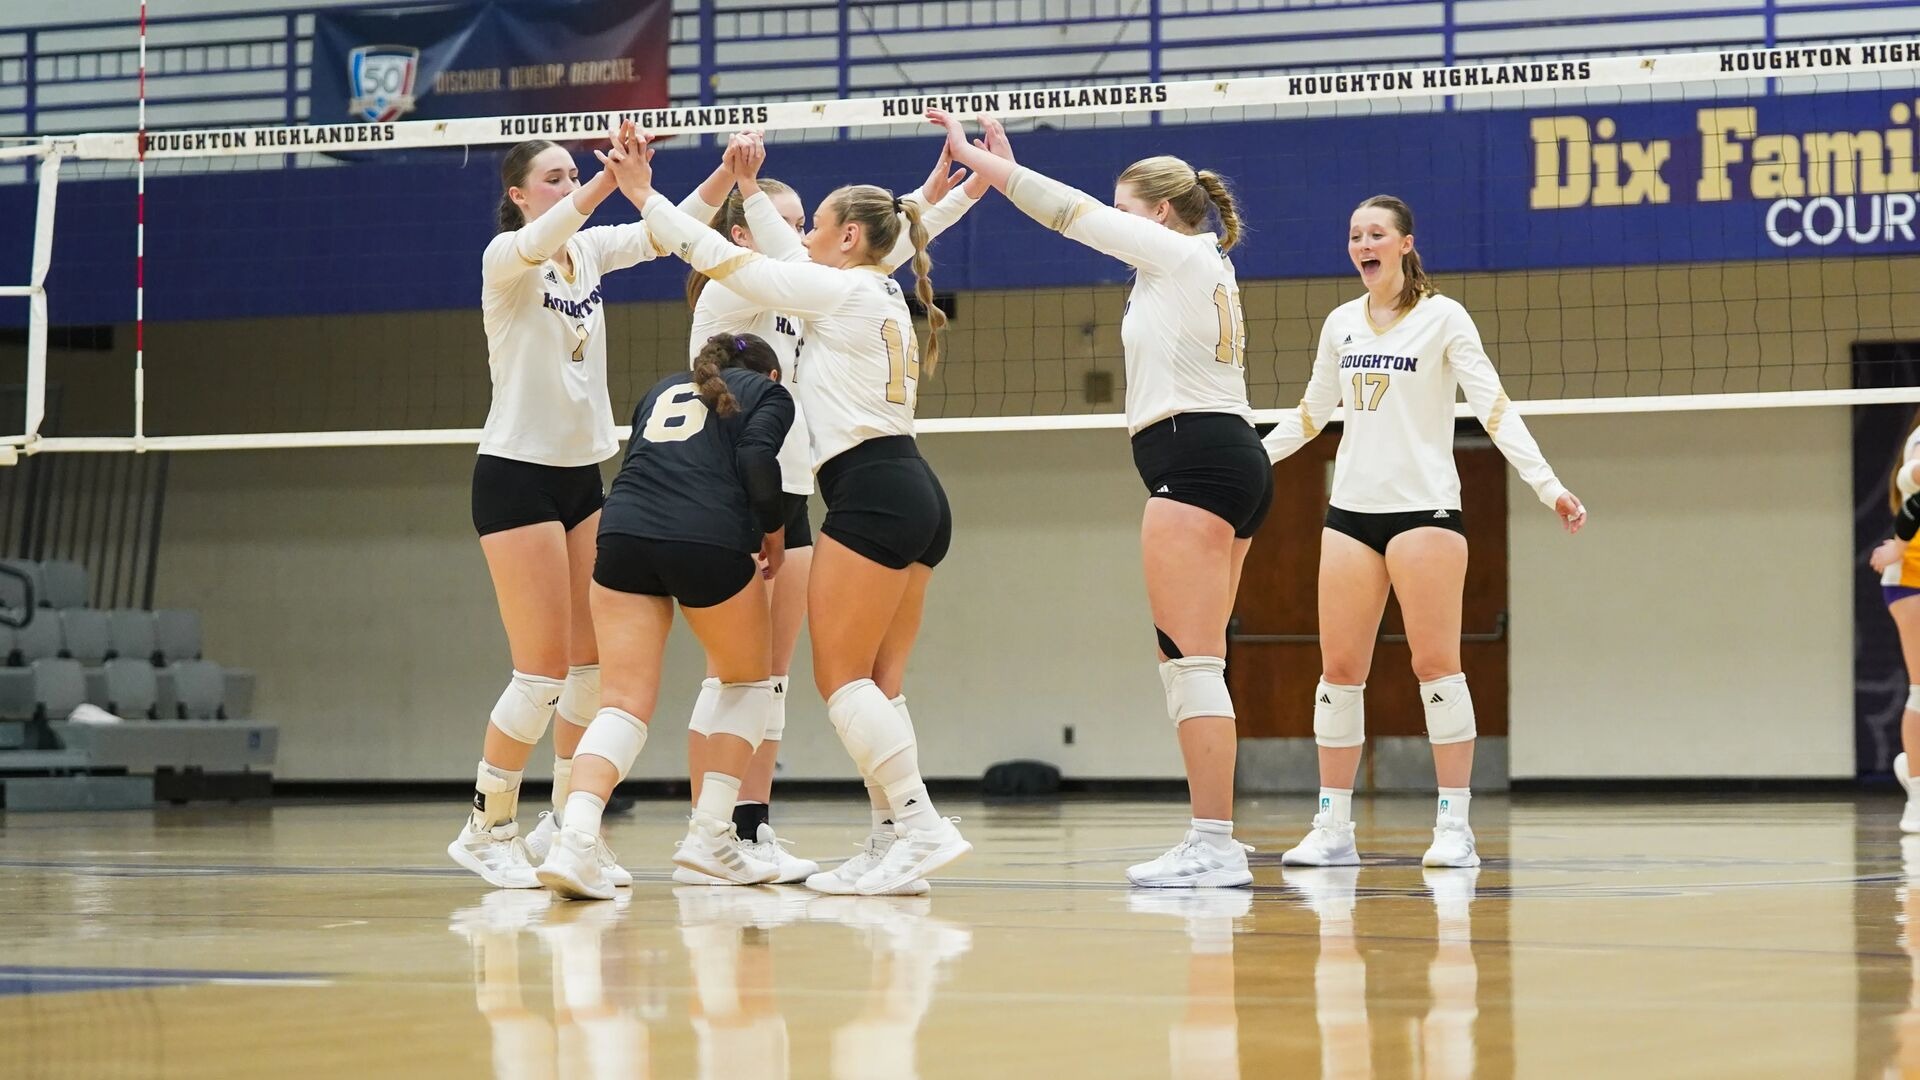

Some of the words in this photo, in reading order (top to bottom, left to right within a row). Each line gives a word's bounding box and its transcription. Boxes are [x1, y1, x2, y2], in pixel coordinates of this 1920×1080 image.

[1720, 47, 1852, 72] HOUGHTON
[364, 66, 401, 94] 50
[1288, 71, 1413, 96] HOUGHTON
[1423, 62, 1591, 89] HIGHLANDERS
[882, 94, 999, 117] HOUGHTON
[1009, 85, 1168, 110] HIGHLANDERS
[145, 131, 247, 151] HOUGHTON
[255, 125, 395, 146] HIGHLANDERS
[500, 113, 610, 136] HOUGHTON
[1530, 115, 1670, 210] Dix
[1697, 98, 1920, 201] Fami
[1765, 193, 1920, 247] COUR
[1352, 373, 1390, 411] 17
[643, 382, 709, 443] 6
